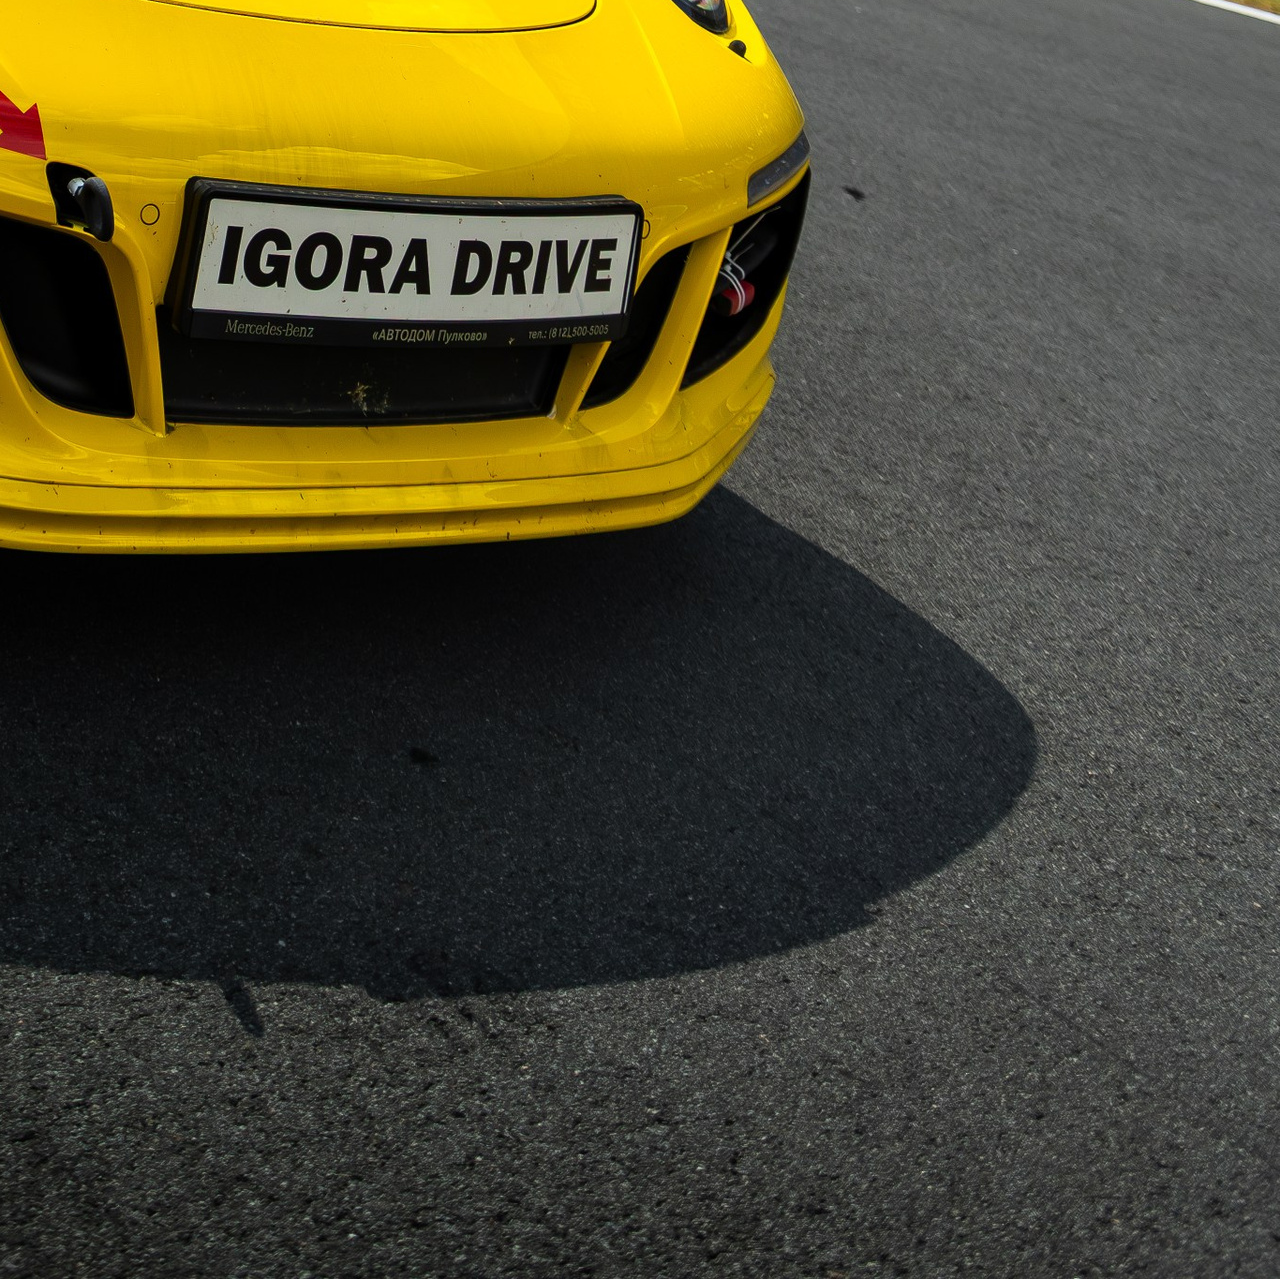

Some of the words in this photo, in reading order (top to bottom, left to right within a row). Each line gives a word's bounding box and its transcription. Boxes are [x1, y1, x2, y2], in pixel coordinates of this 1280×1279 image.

[217, 225, 431, 296] IGORA
[450, 238, 618, 296] DRIVE
[225, 318, 314, 338] Mercedes-Benz
